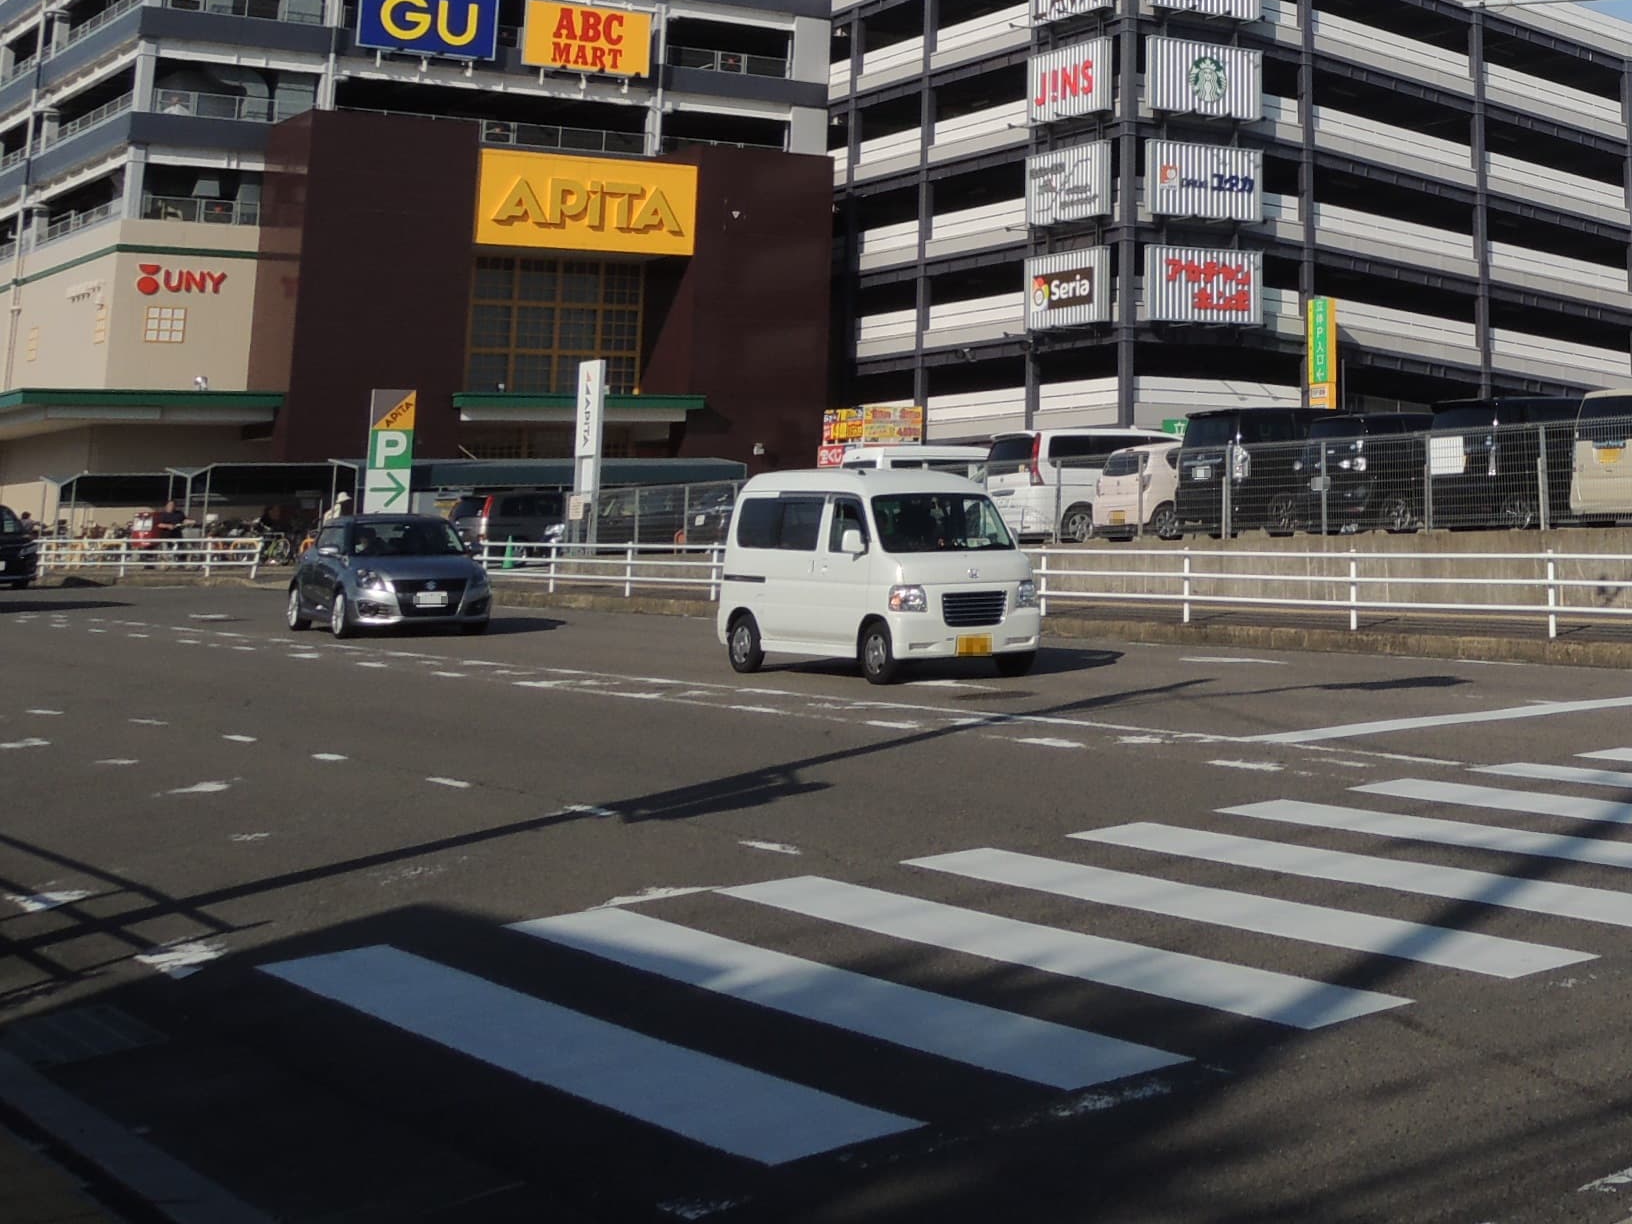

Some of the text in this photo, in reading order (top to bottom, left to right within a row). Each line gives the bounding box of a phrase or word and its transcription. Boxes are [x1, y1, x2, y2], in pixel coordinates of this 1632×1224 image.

[553, 7, 624, 46] ABC
[551, 42, 622, 70] MART
[164, 269, 228, 294] UNY
[1050, 275, 1091, 301] Seria
[375, 430, 407, 468] P
